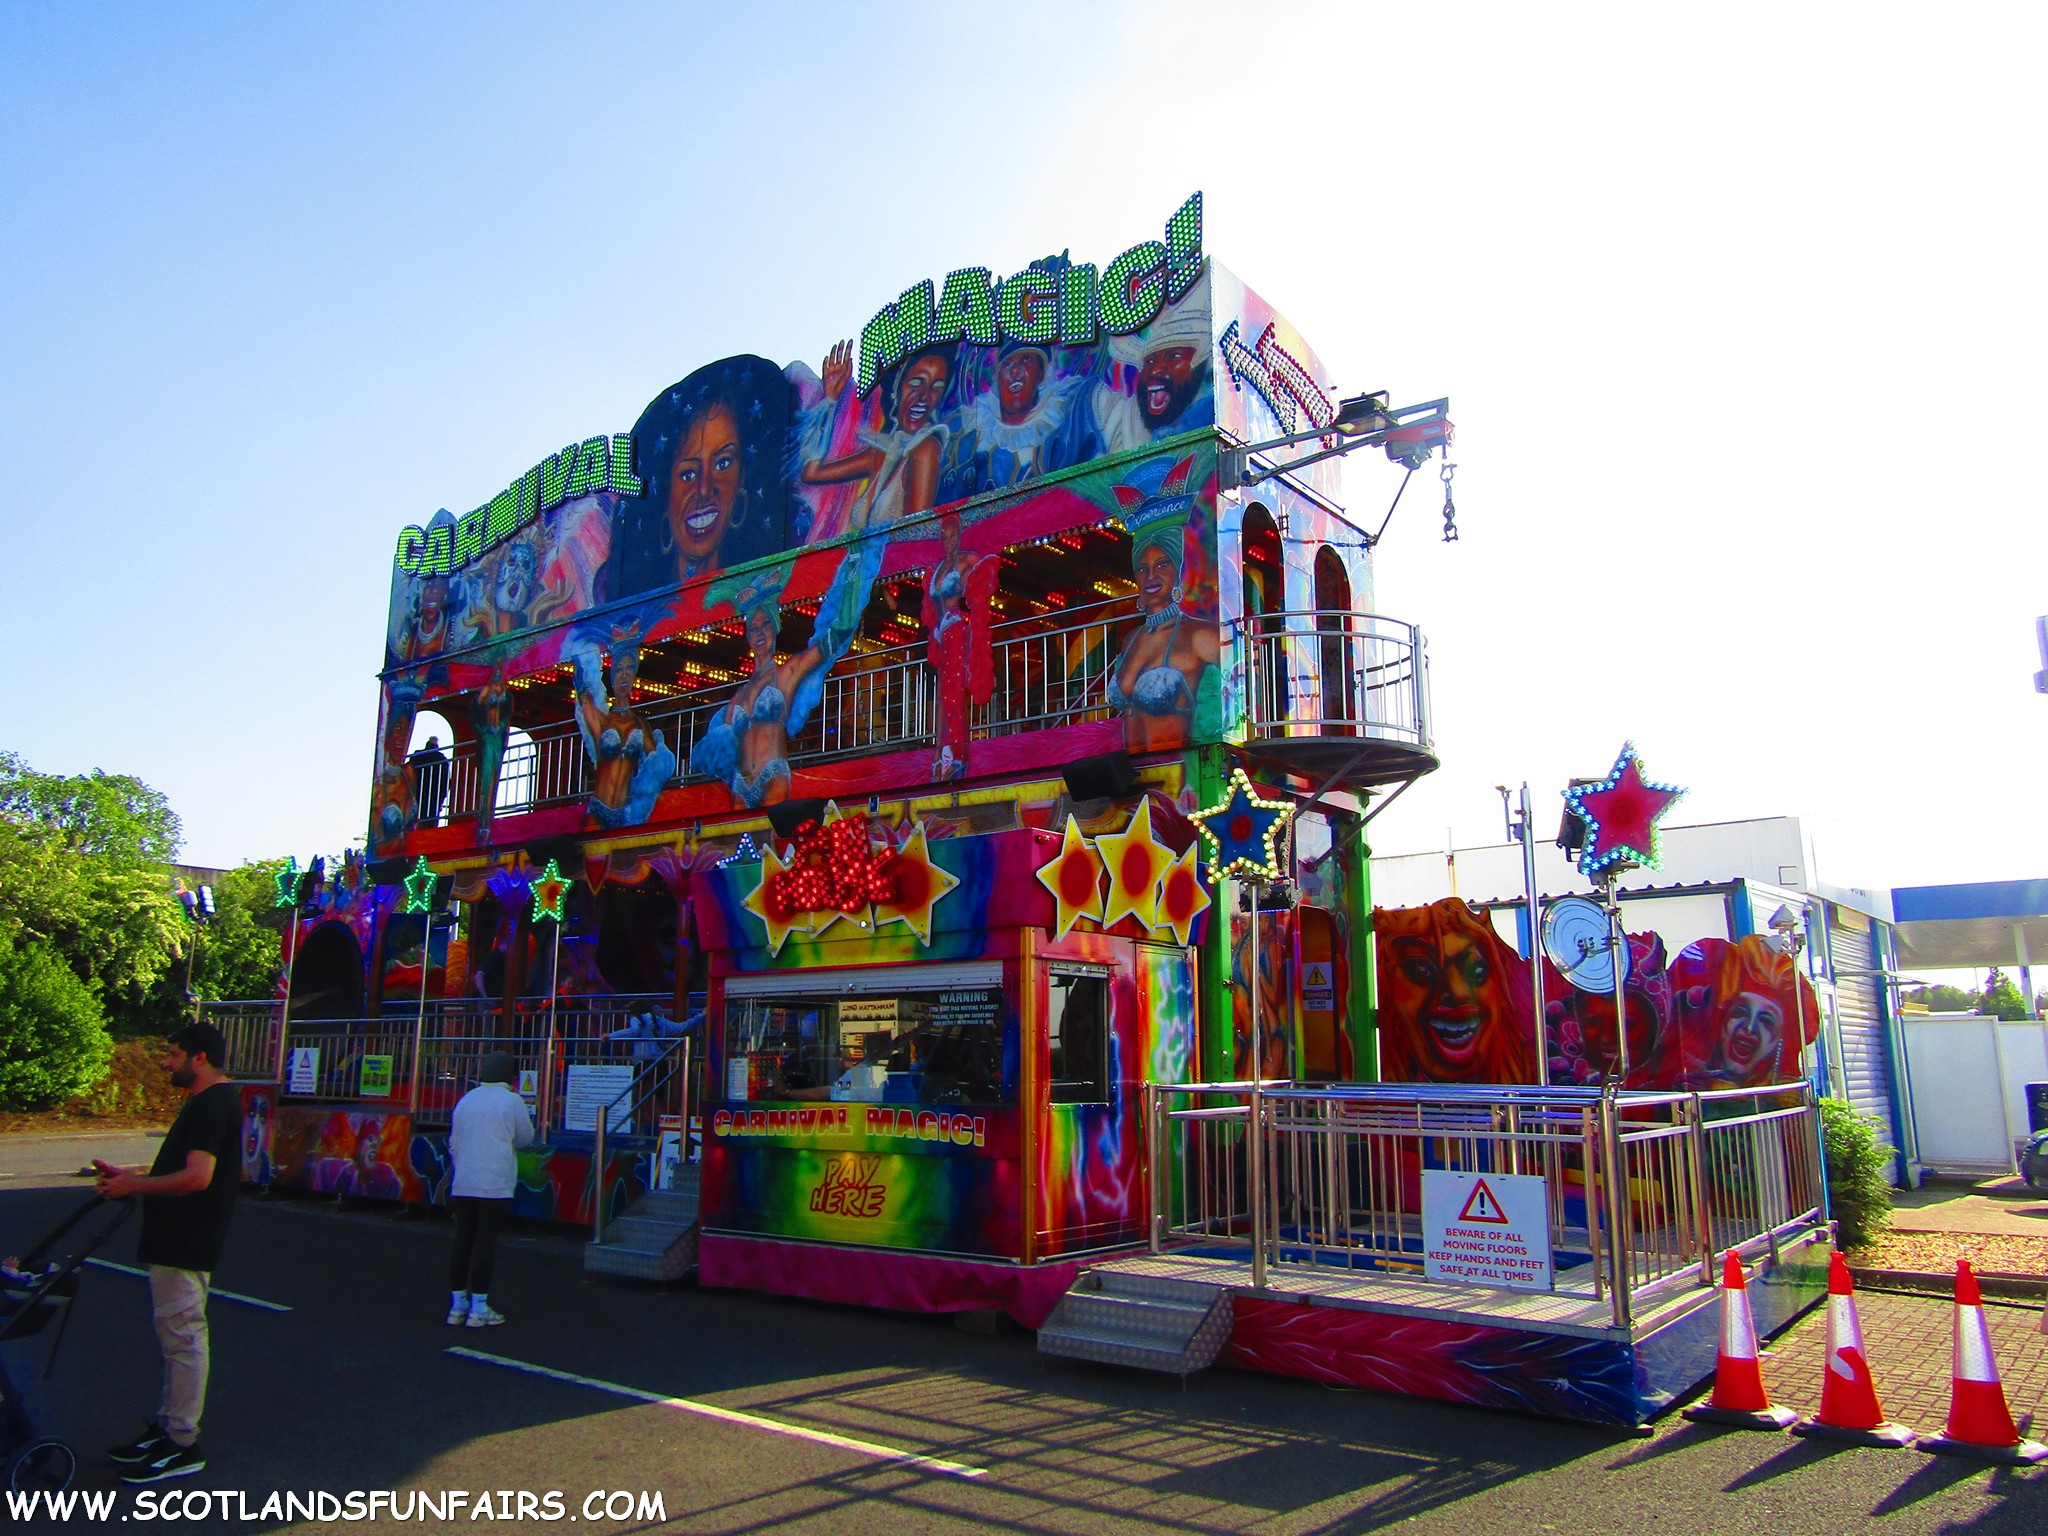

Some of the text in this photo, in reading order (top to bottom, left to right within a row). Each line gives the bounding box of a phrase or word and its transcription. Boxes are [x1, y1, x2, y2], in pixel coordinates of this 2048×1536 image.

[396, 190, 1203, 579] CARNIVAL MAGIC!
[1124, 500, 1186, 531] Experience
[939, 991, 988, 1004] WARNING
[713, 1107, 986, 1147] CARNIVAL MAGIC!
[824, 1156, 881, 1188] PAY
[810, 1184, 886, 1218] HERE
[1445, 1228, 1524, 1242] BEWARE OF ALL
[1428, 1251, 1544, 1270] KEEP HANDS AND FEET
[1443, 1240, 1527, 1256] MOVING FLOORS
[1440, 1265, 1534, 1281] SAFE AT ALL TIMES
